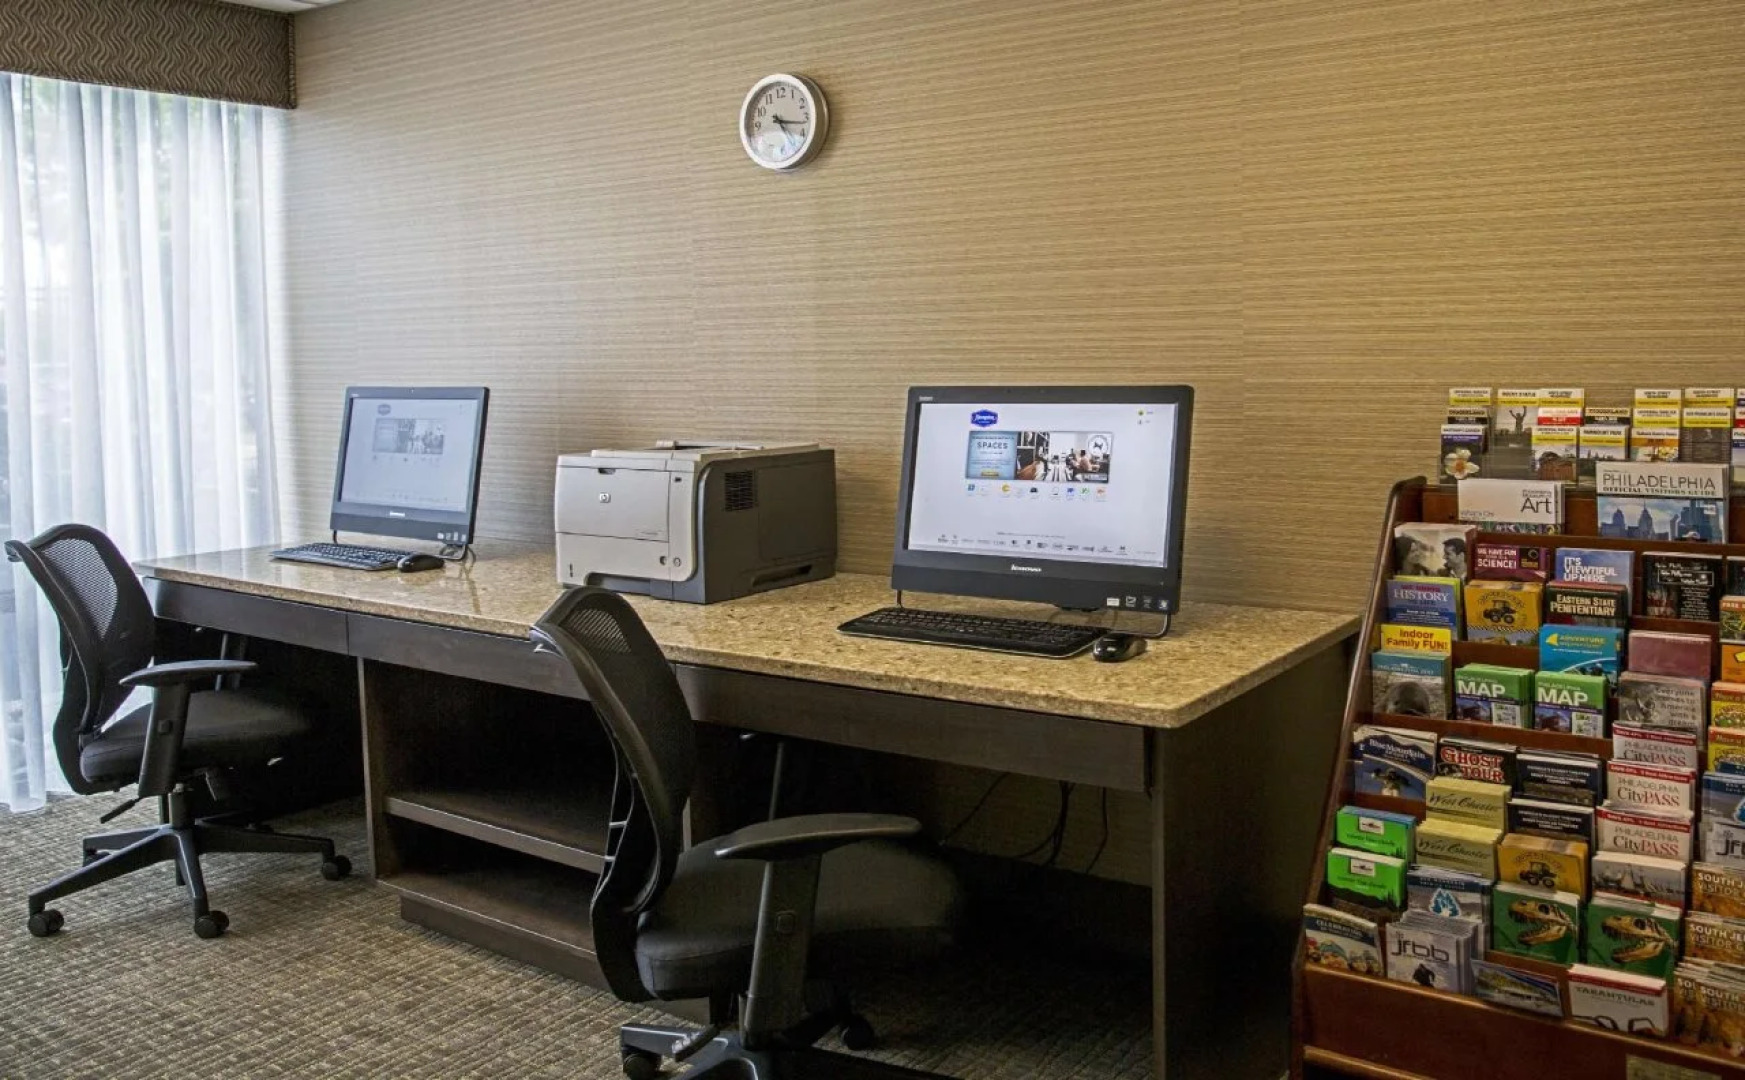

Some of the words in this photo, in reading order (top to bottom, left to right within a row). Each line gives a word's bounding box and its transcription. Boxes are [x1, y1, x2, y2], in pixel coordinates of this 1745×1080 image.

[765, 94, 773, 105] 11
[776, 87, 786, 99] 12
[798, 97, 805, 109] 2
[757, 106, 766, 117] 10
[754, 121, 762, 131] 9
[1602, 473, 1716, 490] PHILADELPHIA
[1520, 497, 1552, 514] Art
[1477, 559, 1517, 569] SCIENCE!
[1564, 557, 1582, 566] IT'S
[1564, 564, 1617, 576] VIEWTIFUL
[1564, 573, 1578, 581] UP
[1394, 588, 1451, 602] HISTORY
[1556, 595, 1592, 606] EASTERN
[1593, 597, 1616, 607] STATE
[1551, 602, 1616, 616] PENITENTIARY
[1400, 629, 1435, 639] Indoor
[1387, 638, 1420, 650] Family
[1422, 641, 1448, 650] FUN!
[1458, 680, 1505, 698] MAP
[1537, 686, 1588, 706] MAP
[1440, 746, 1504, 768] GHOST
[1623, 749, 1686, 767] CityPASS
[1461, 765, 1505, 784] TOUR
[1617, 787, 1680, 807] CityPASS
[1613, 836, 1680, 856] CityPASS
[1697, 872, 1735, 886] SOUTH
[1690, 923, 1727, 939] SOUTH
[1575, 986, 1655, 1006] TARANTULAS
[1701, 986, 1739, 1002] SOUTH
